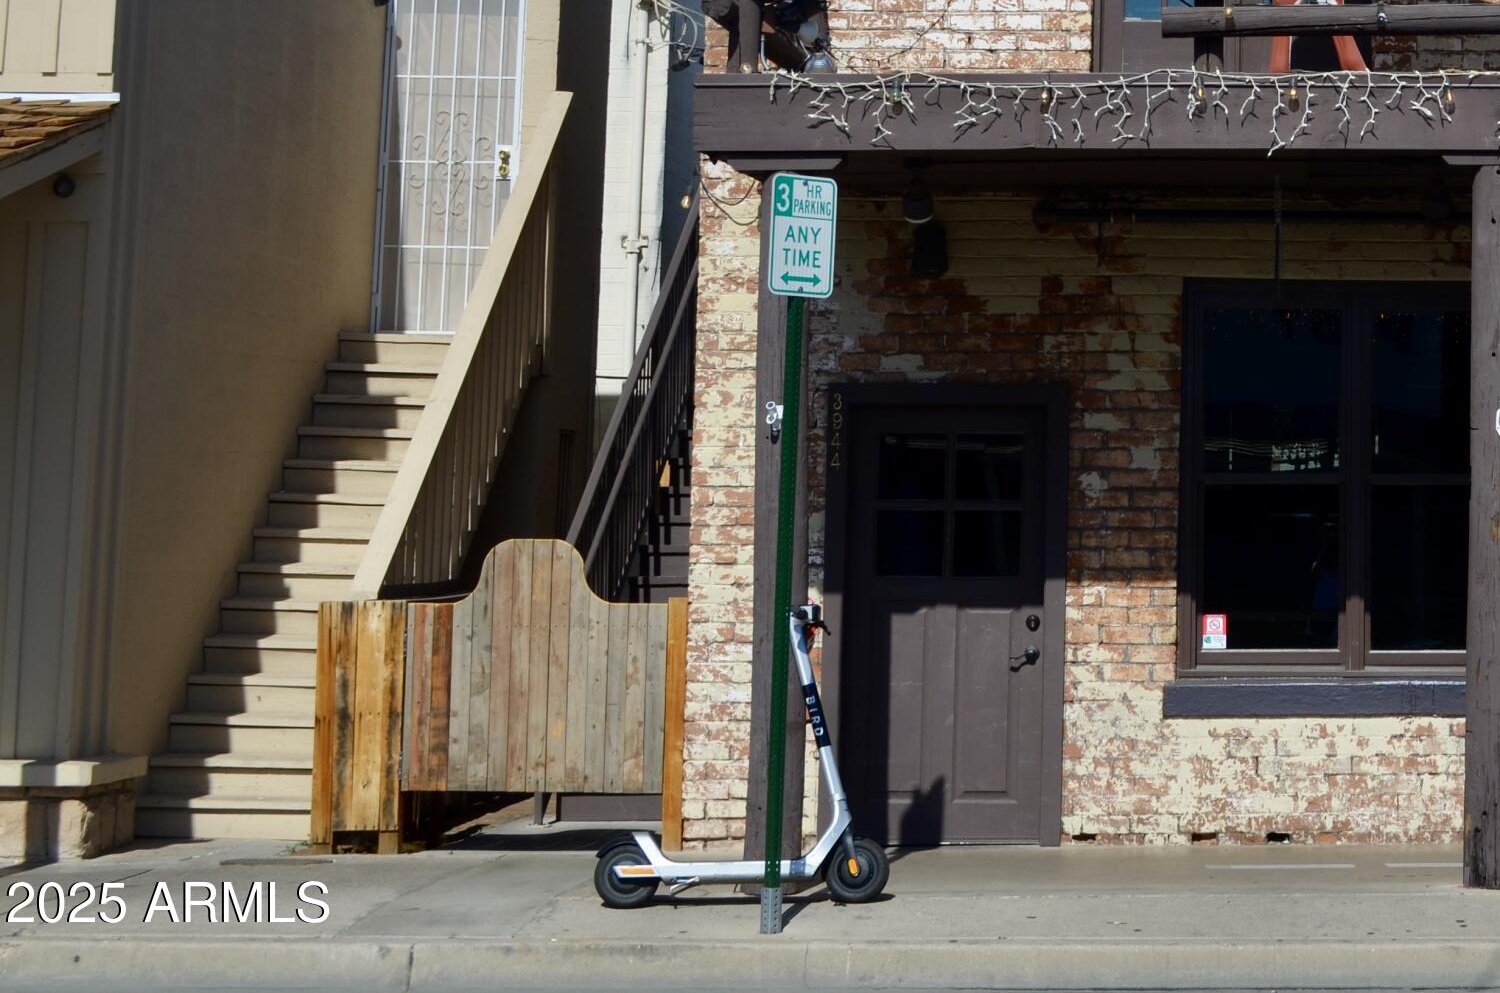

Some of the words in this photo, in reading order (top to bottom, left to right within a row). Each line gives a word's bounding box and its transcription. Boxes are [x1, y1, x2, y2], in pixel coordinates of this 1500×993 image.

[776, 183, 791, 212] 3
[806, 185, 822, 199] HR
[793, 198, 832, 216] PARKING
[784, 225, 822, 245] ANY
[783, 248, 822, 269] TIME
[831, 393, 843, 470] 3944
[805, 695, 824, 737] BIRD
